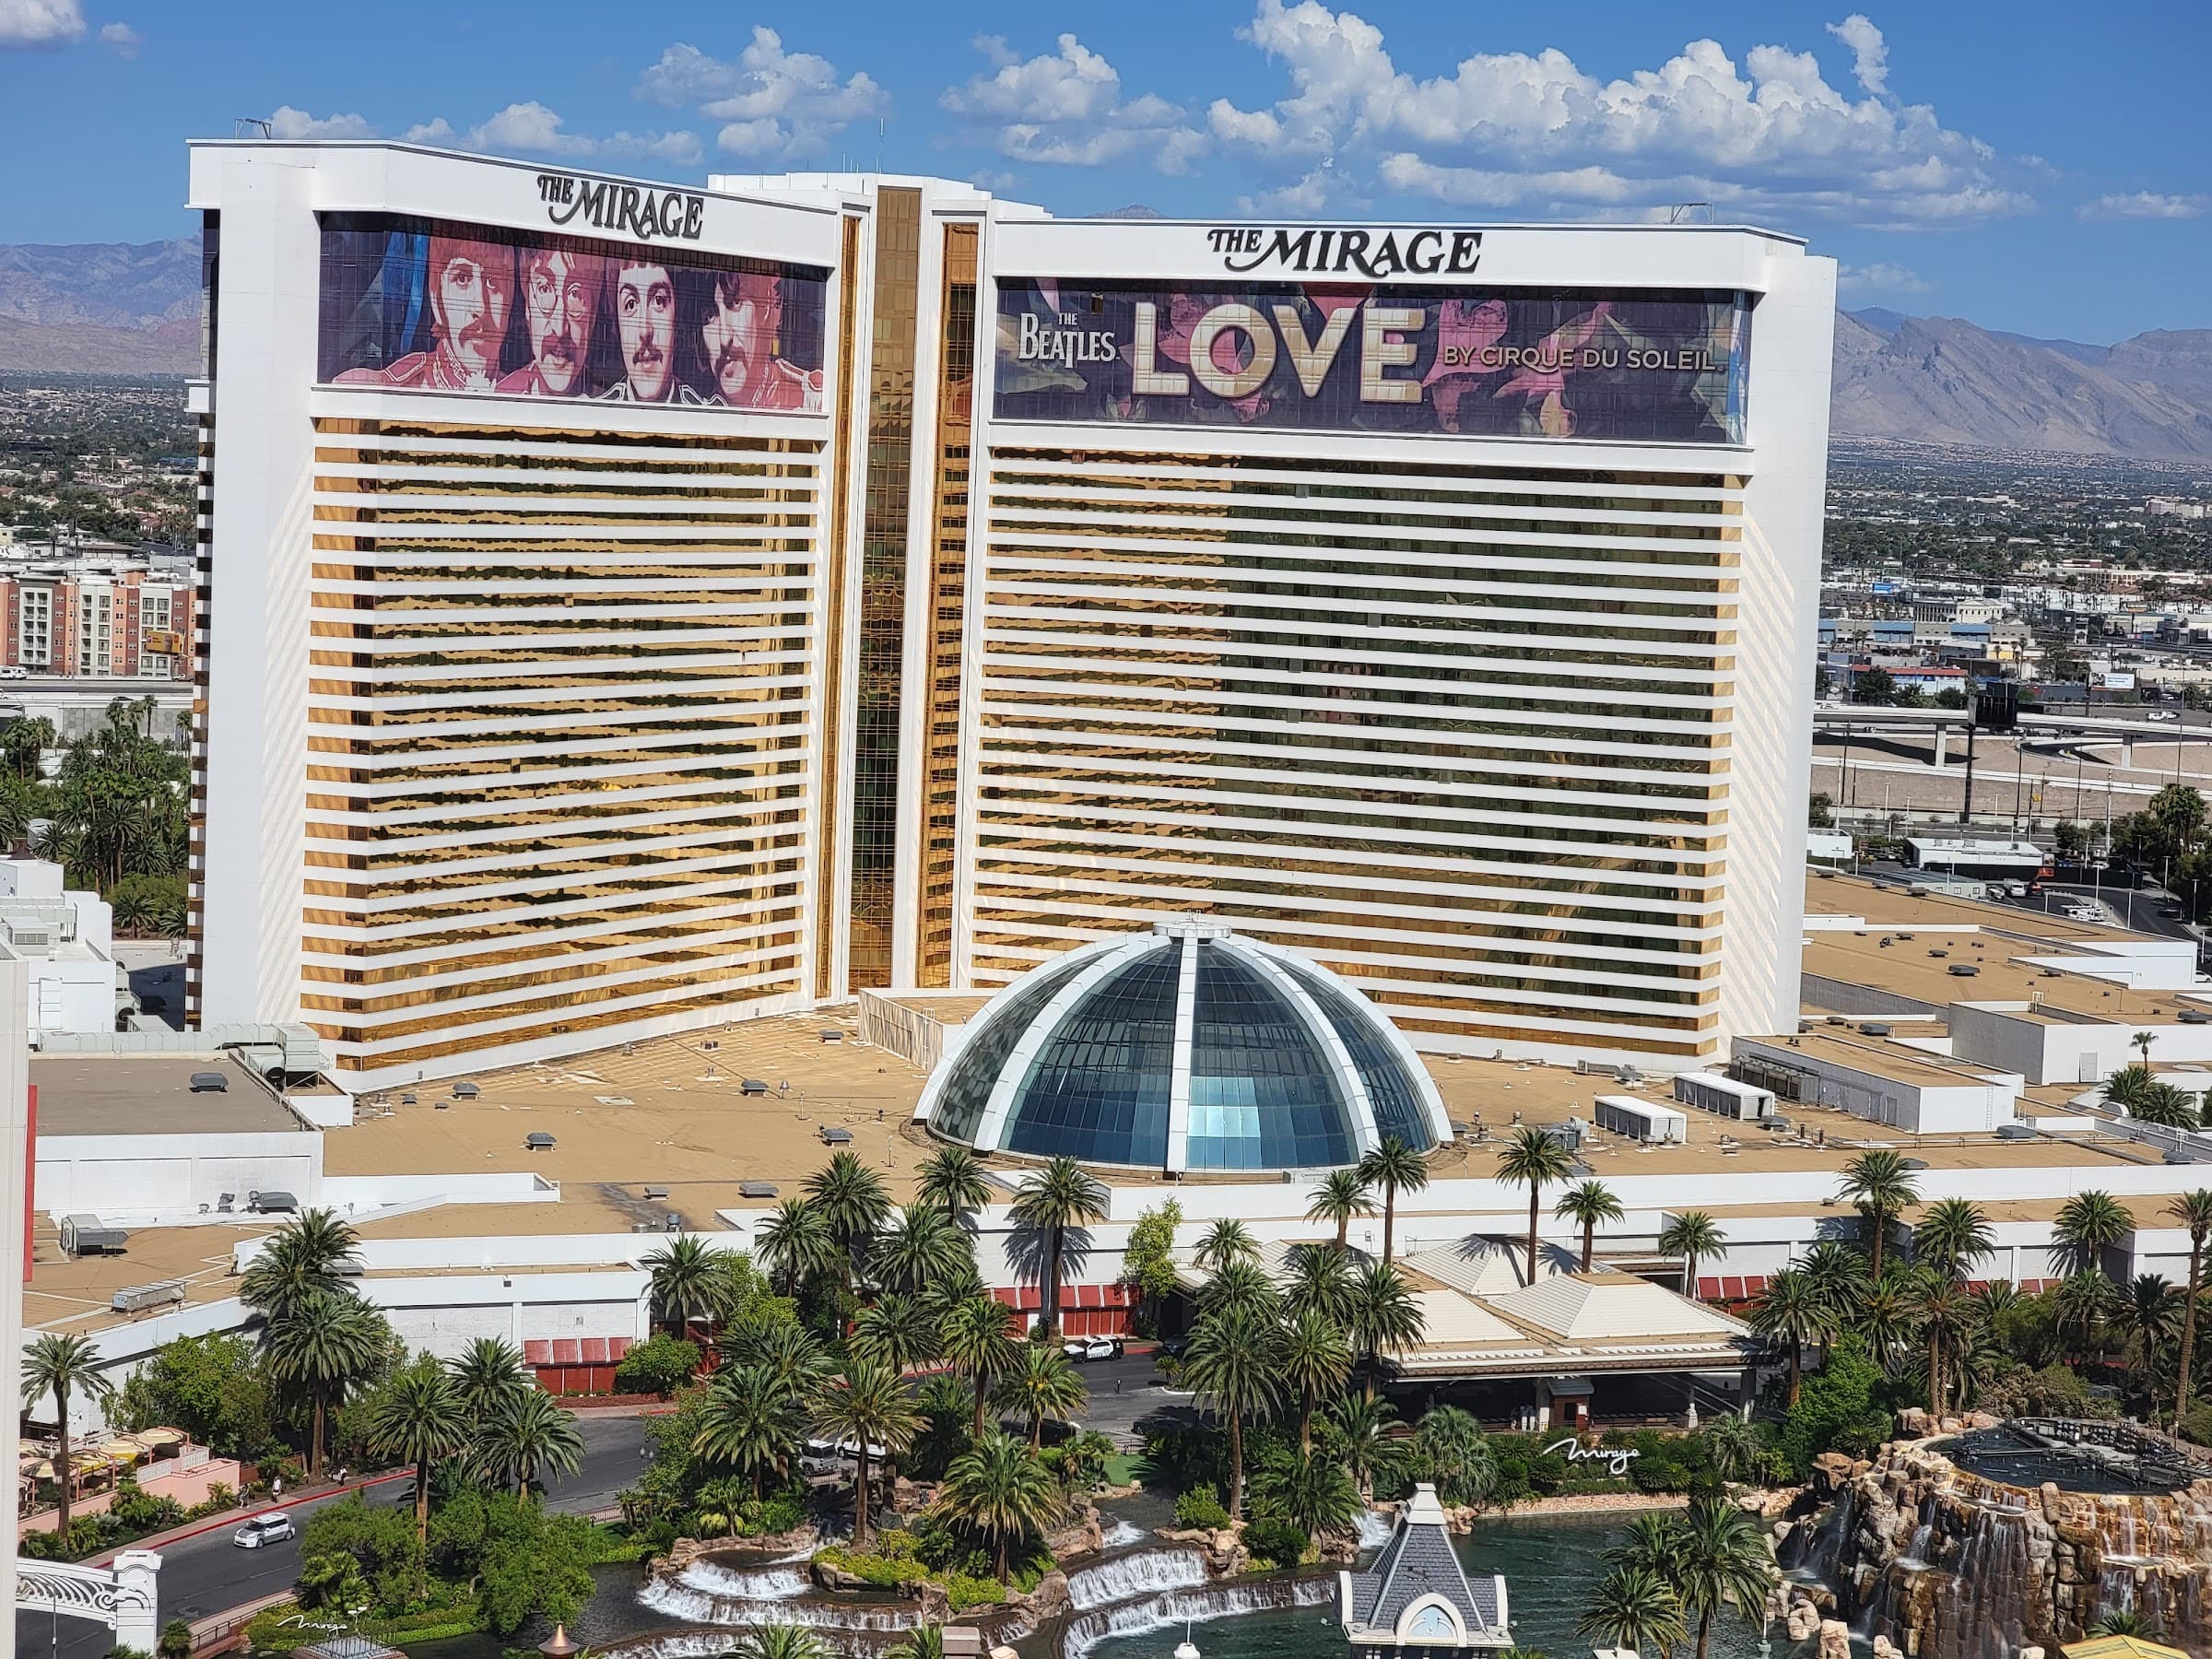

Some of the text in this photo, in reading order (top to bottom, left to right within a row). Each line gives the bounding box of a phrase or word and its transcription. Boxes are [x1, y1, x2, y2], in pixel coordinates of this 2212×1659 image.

[537, 174, 704, 240] THE MIRAGE
[1207, 229, 1482, 278] THE MIRAGE
[1018, 312, 1116, 369] BEATLES
[1057, 312, 1077, 325] THE
[1132, 301, 1427, 403] LOVE
[1444, 346, 1715, 373] BY CIRQUE DU SOLEIL
[1539, 1438, 1641, 1474] Mirage
